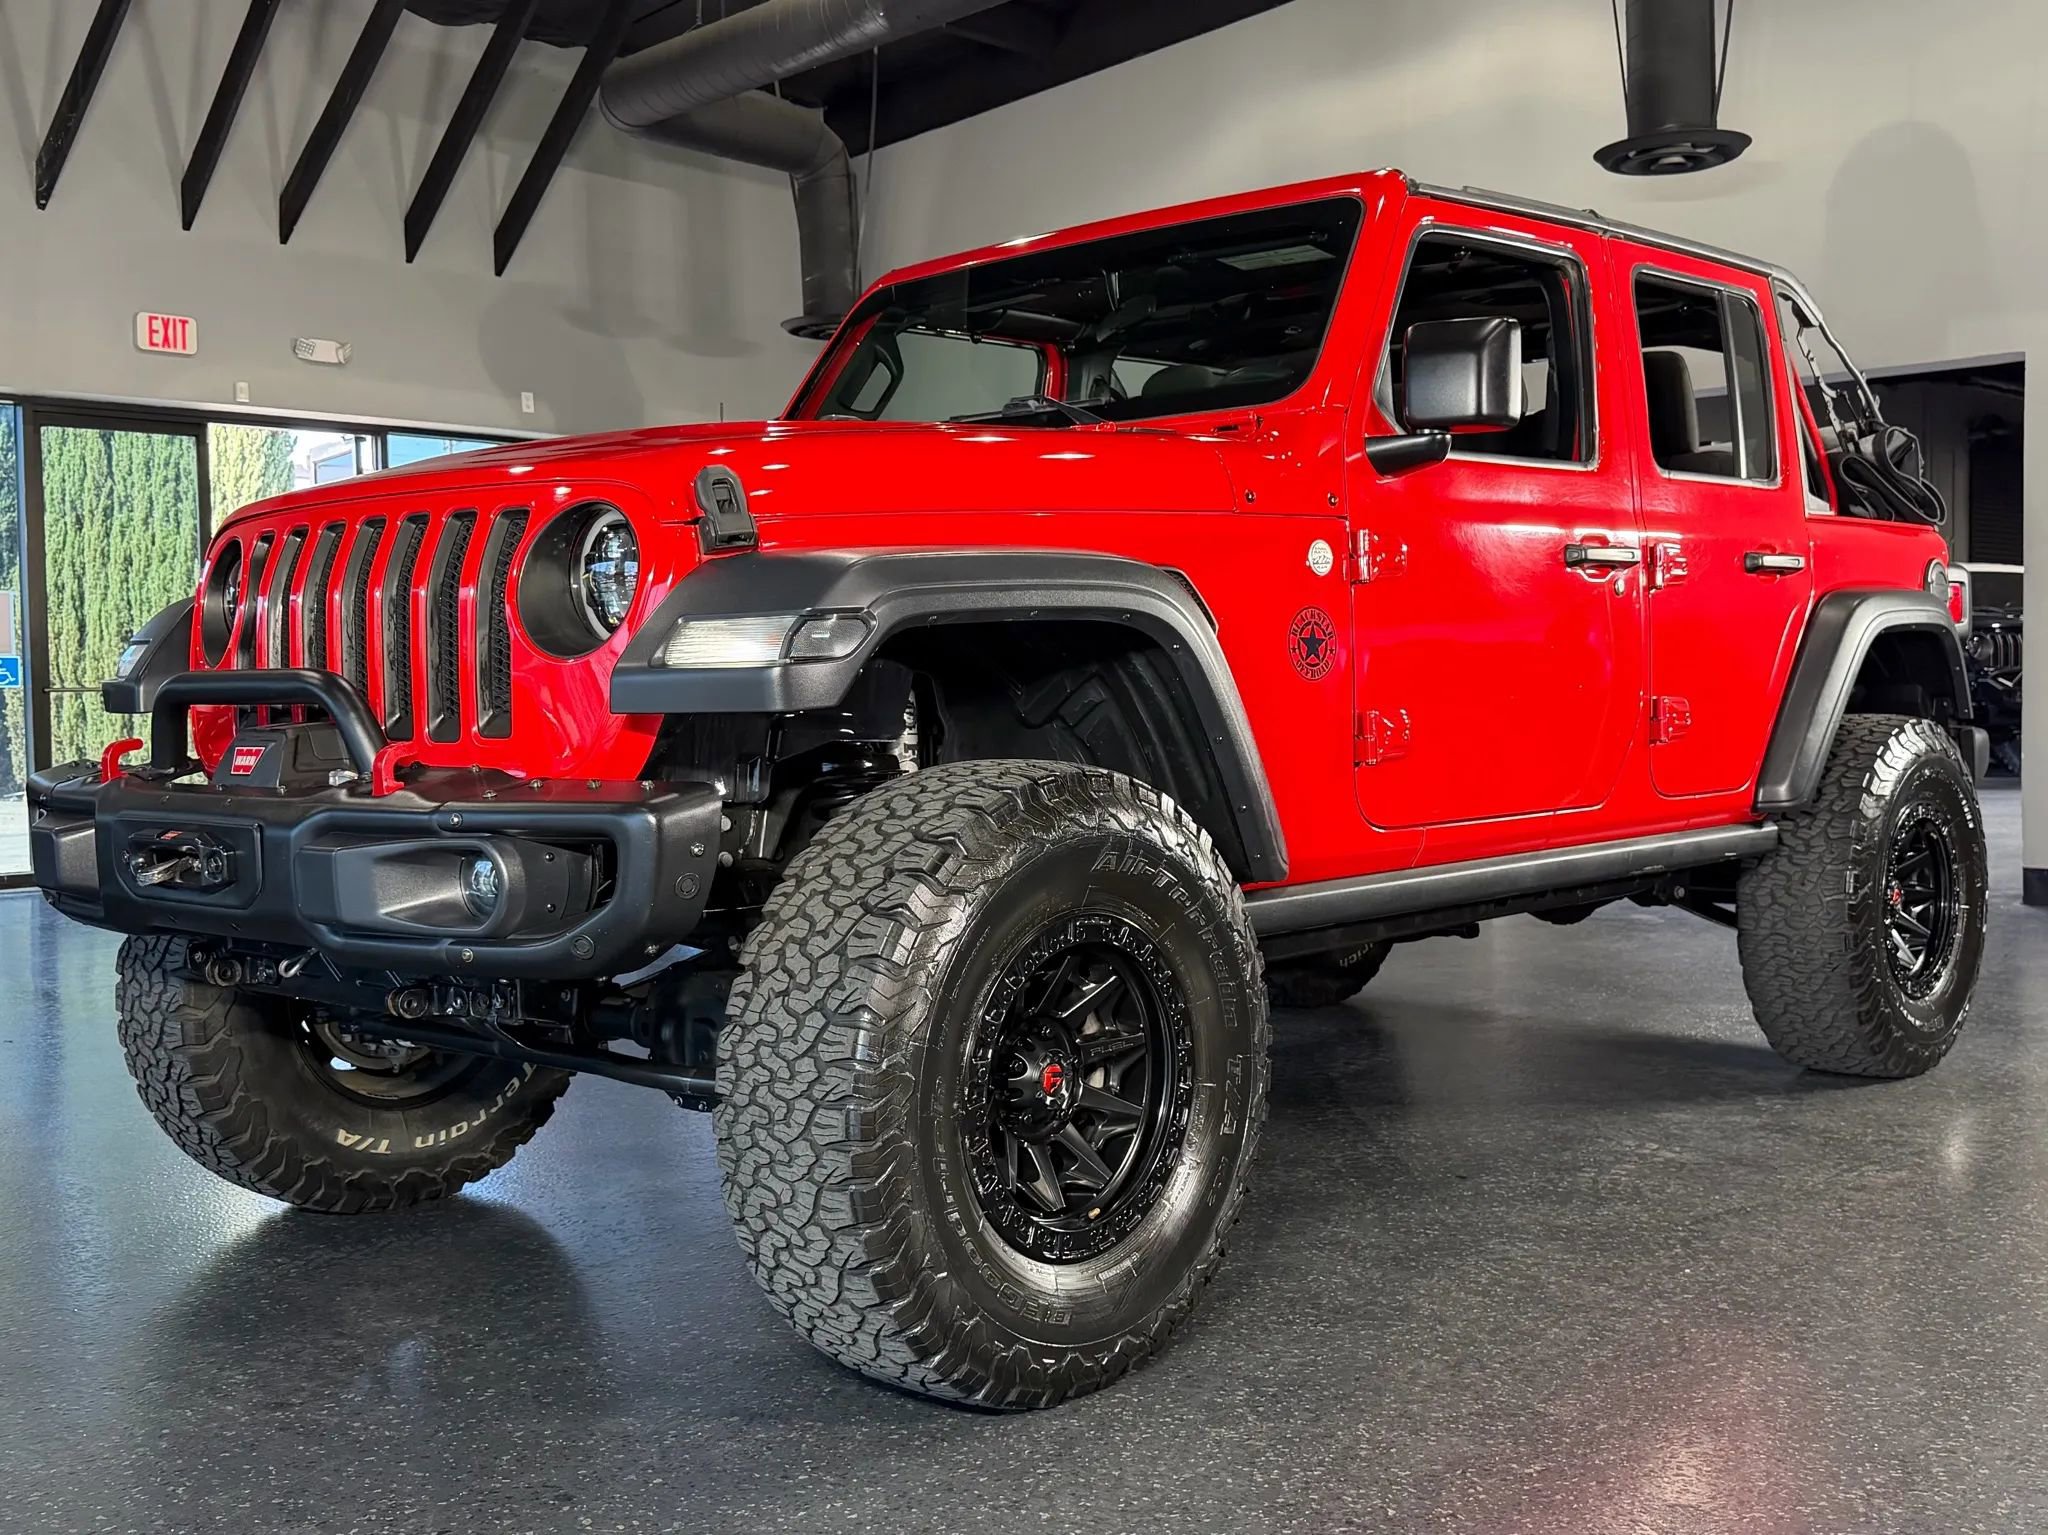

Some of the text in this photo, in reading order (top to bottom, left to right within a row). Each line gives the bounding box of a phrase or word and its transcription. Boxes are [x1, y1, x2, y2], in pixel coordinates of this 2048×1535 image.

[147, 315, 189, 350] EXIT
[336, 1062, 537, 1155] Terrain T/A
